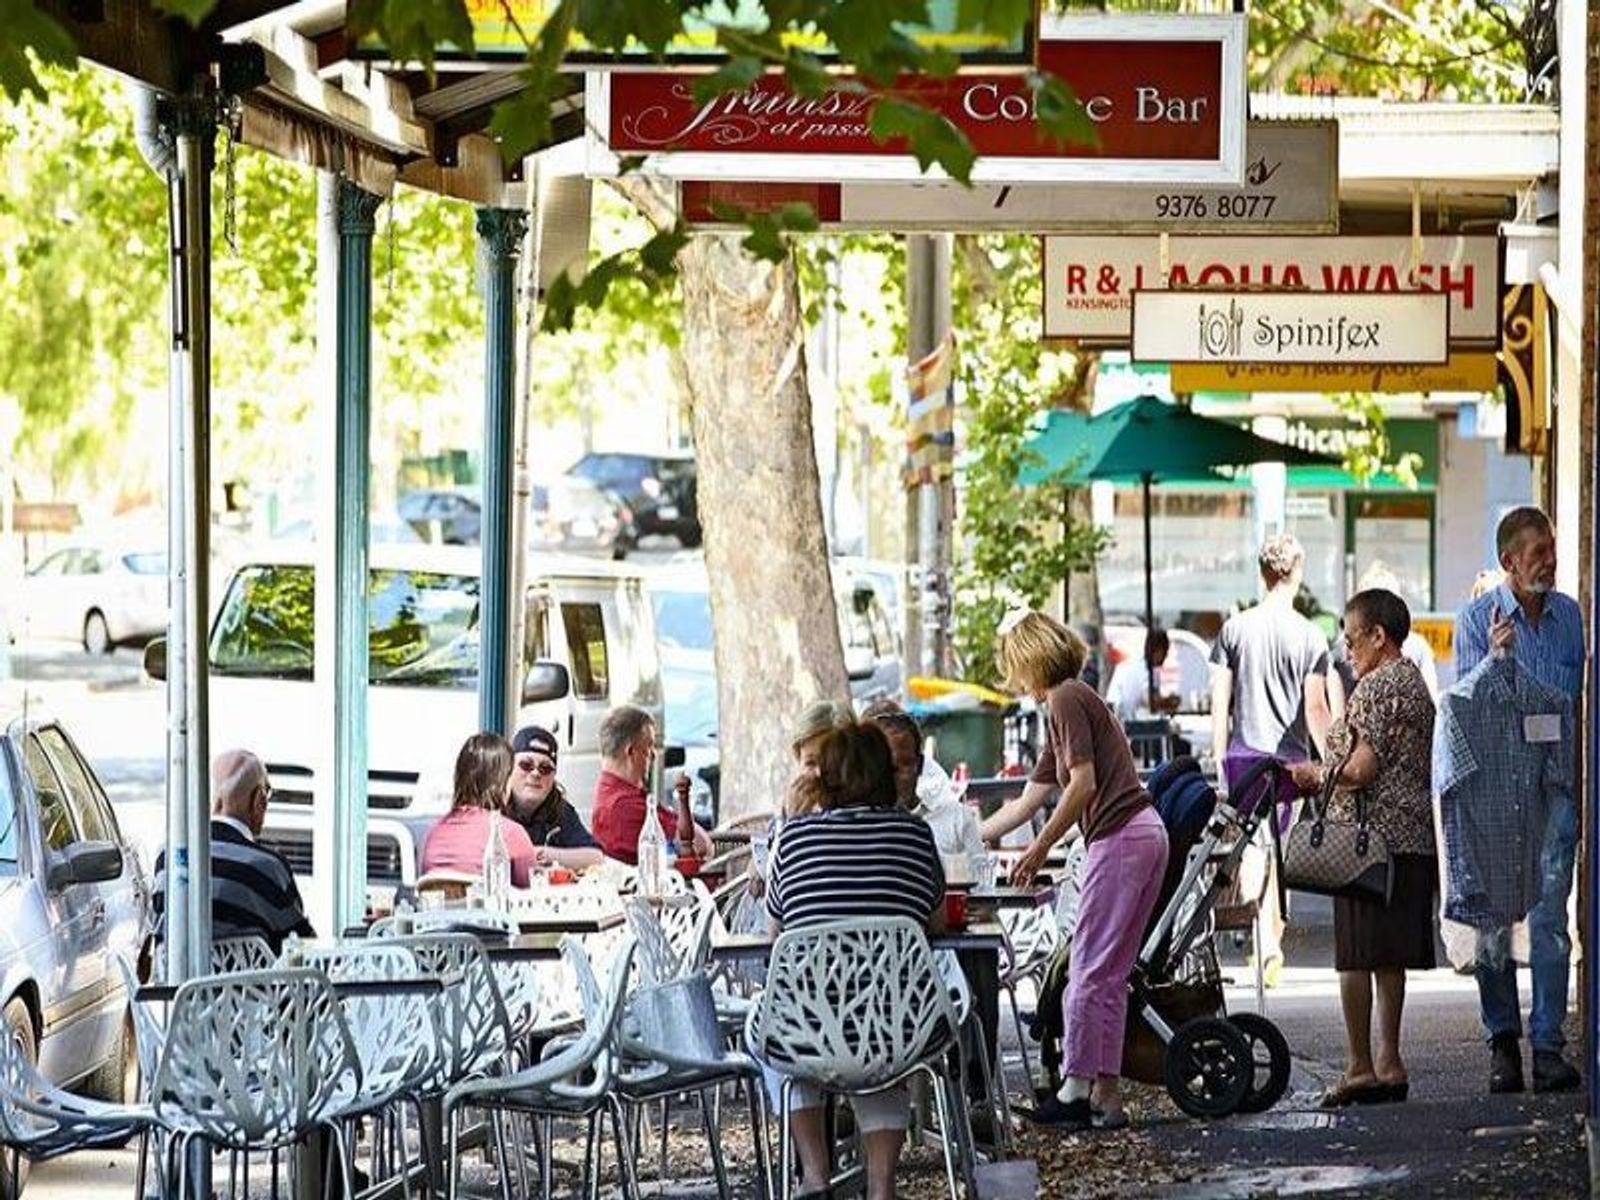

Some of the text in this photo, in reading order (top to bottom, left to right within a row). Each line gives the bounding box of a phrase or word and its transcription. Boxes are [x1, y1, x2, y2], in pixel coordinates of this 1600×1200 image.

[963, 84, 1208, 122] Coe Bar
[1156, 194, 1277, 218] 9376 8077
[1066, 264, 1087, 295] R
[1095, 264, 1121, 295] &
[1253, 315, 1380, 353] Spinifex
